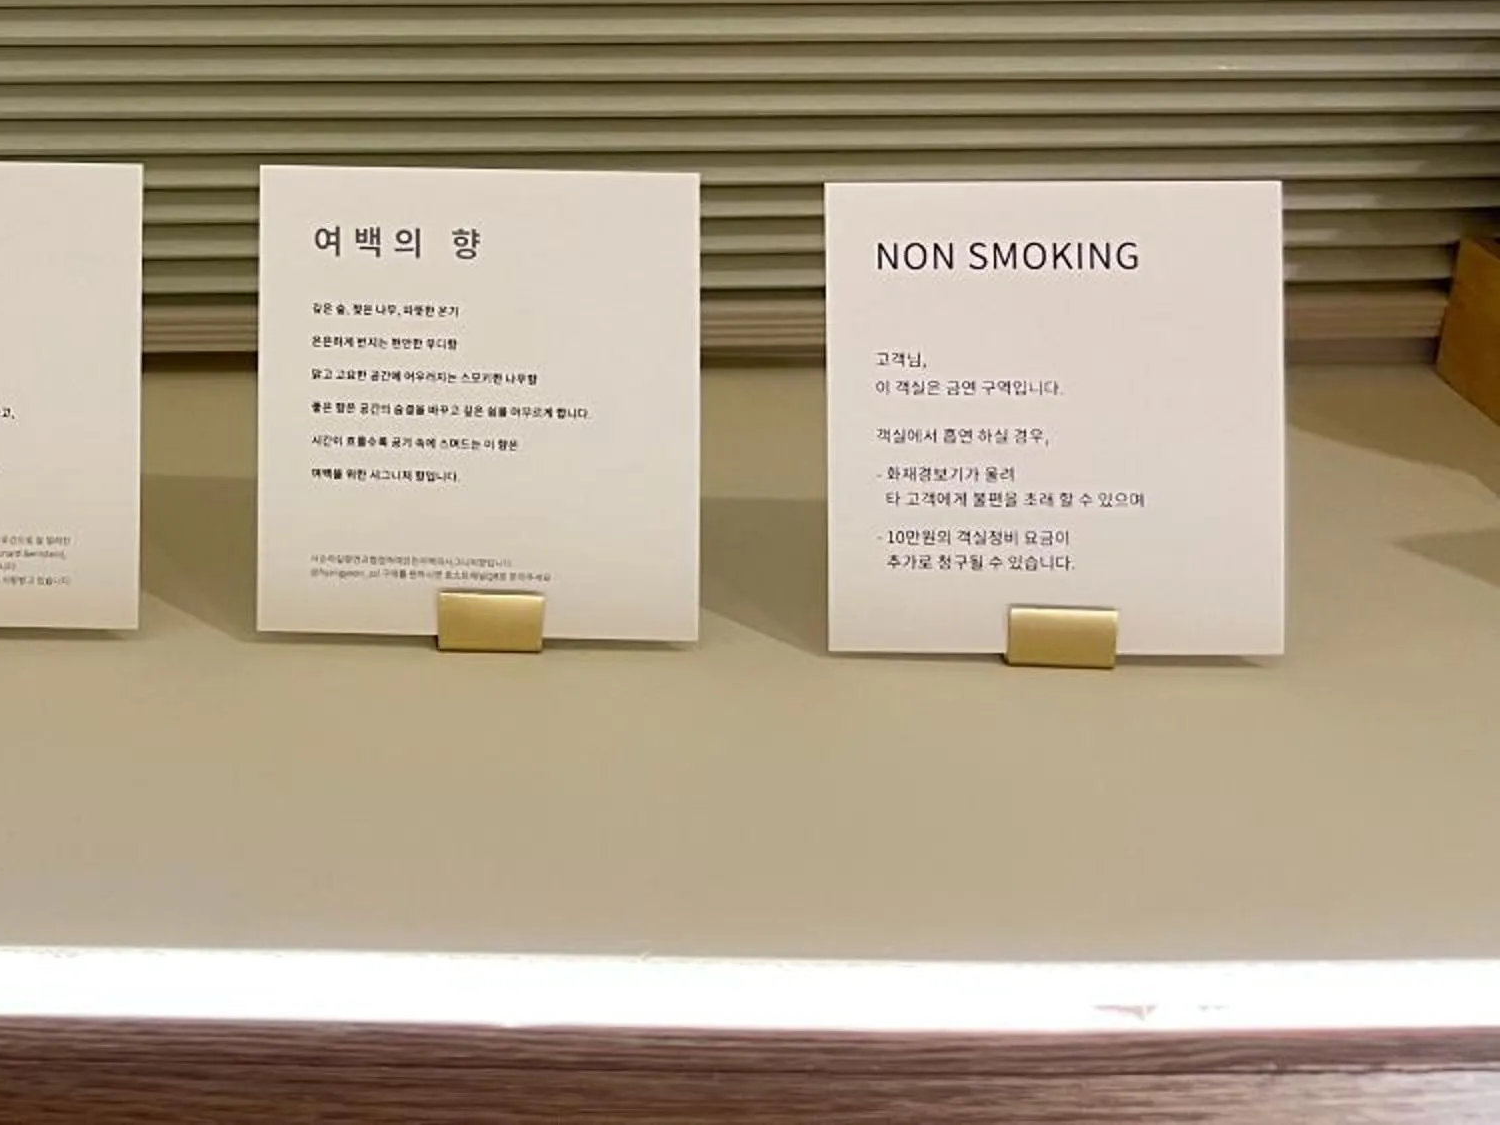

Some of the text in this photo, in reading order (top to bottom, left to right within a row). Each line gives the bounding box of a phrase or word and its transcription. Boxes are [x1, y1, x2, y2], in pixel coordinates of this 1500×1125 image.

[314, 225, 480, 260] 여백의 향
[877, 241, 1139, 270] NON SMOKING
[876, 352, 927, 371] 고객님,
[875, 380, 1064, 396] 이 객실은 금연 구역입니다.
[877, 428, 1049, 447] 객실에서 흡연 하실 경우,
[887, 466, 980, 482] 화재경보기가
[985, 466, 1015, 483] 울려
[885, 491, 1145, 508] 타 고객에게 불편을 초래 할 수 있으며
[888, 530, 952, 546] 10만원의
[956, 530, 1019, 546] 객실정비
[1024, 530, 1070, 547] 요금이
[887, 554, 1074, 572] 추가로 청구될 수 있습니다.
